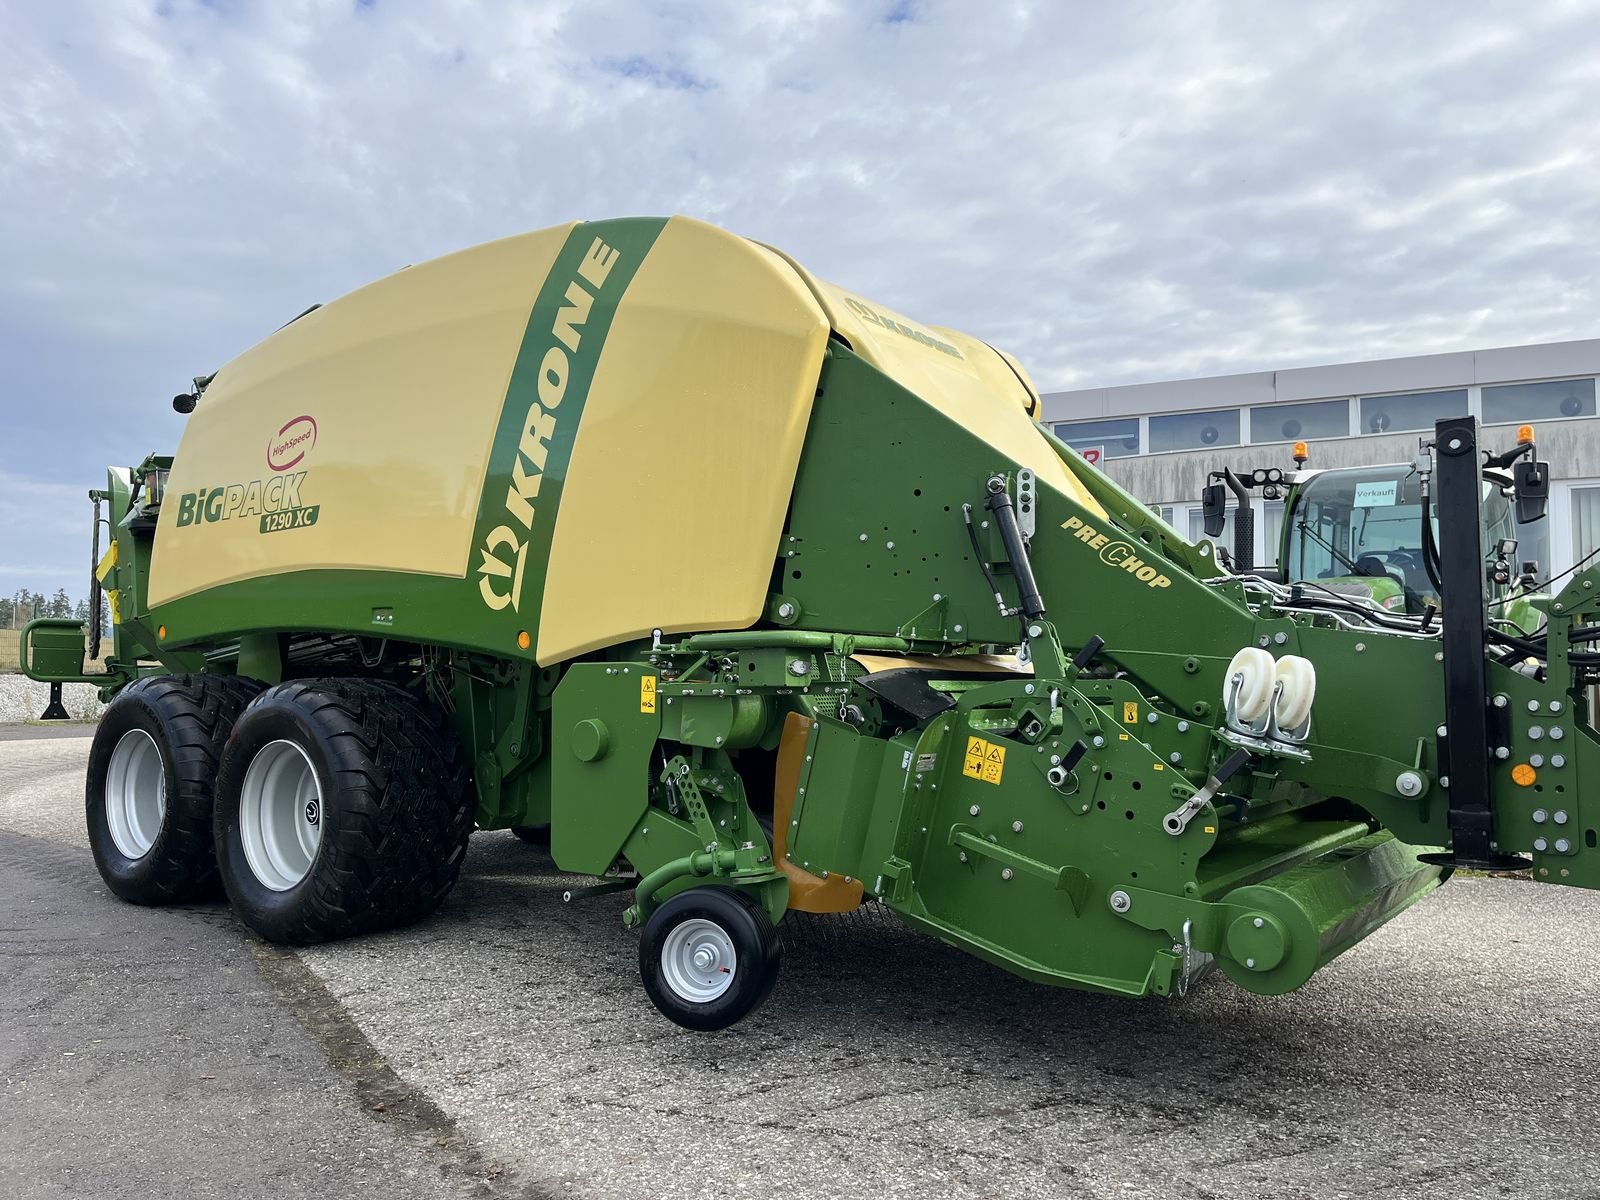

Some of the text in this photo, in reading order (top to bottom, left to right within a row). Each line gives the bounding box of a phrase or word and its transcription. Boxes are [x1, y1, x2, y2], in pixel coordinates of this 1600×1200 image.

[505, 236, 620, 530] KRONE
[272, 428, 312, 457] HighSpeed
[1357, 489, 1395, 497] Verkauft
[265, 508, 313, 532] 1290 XC
